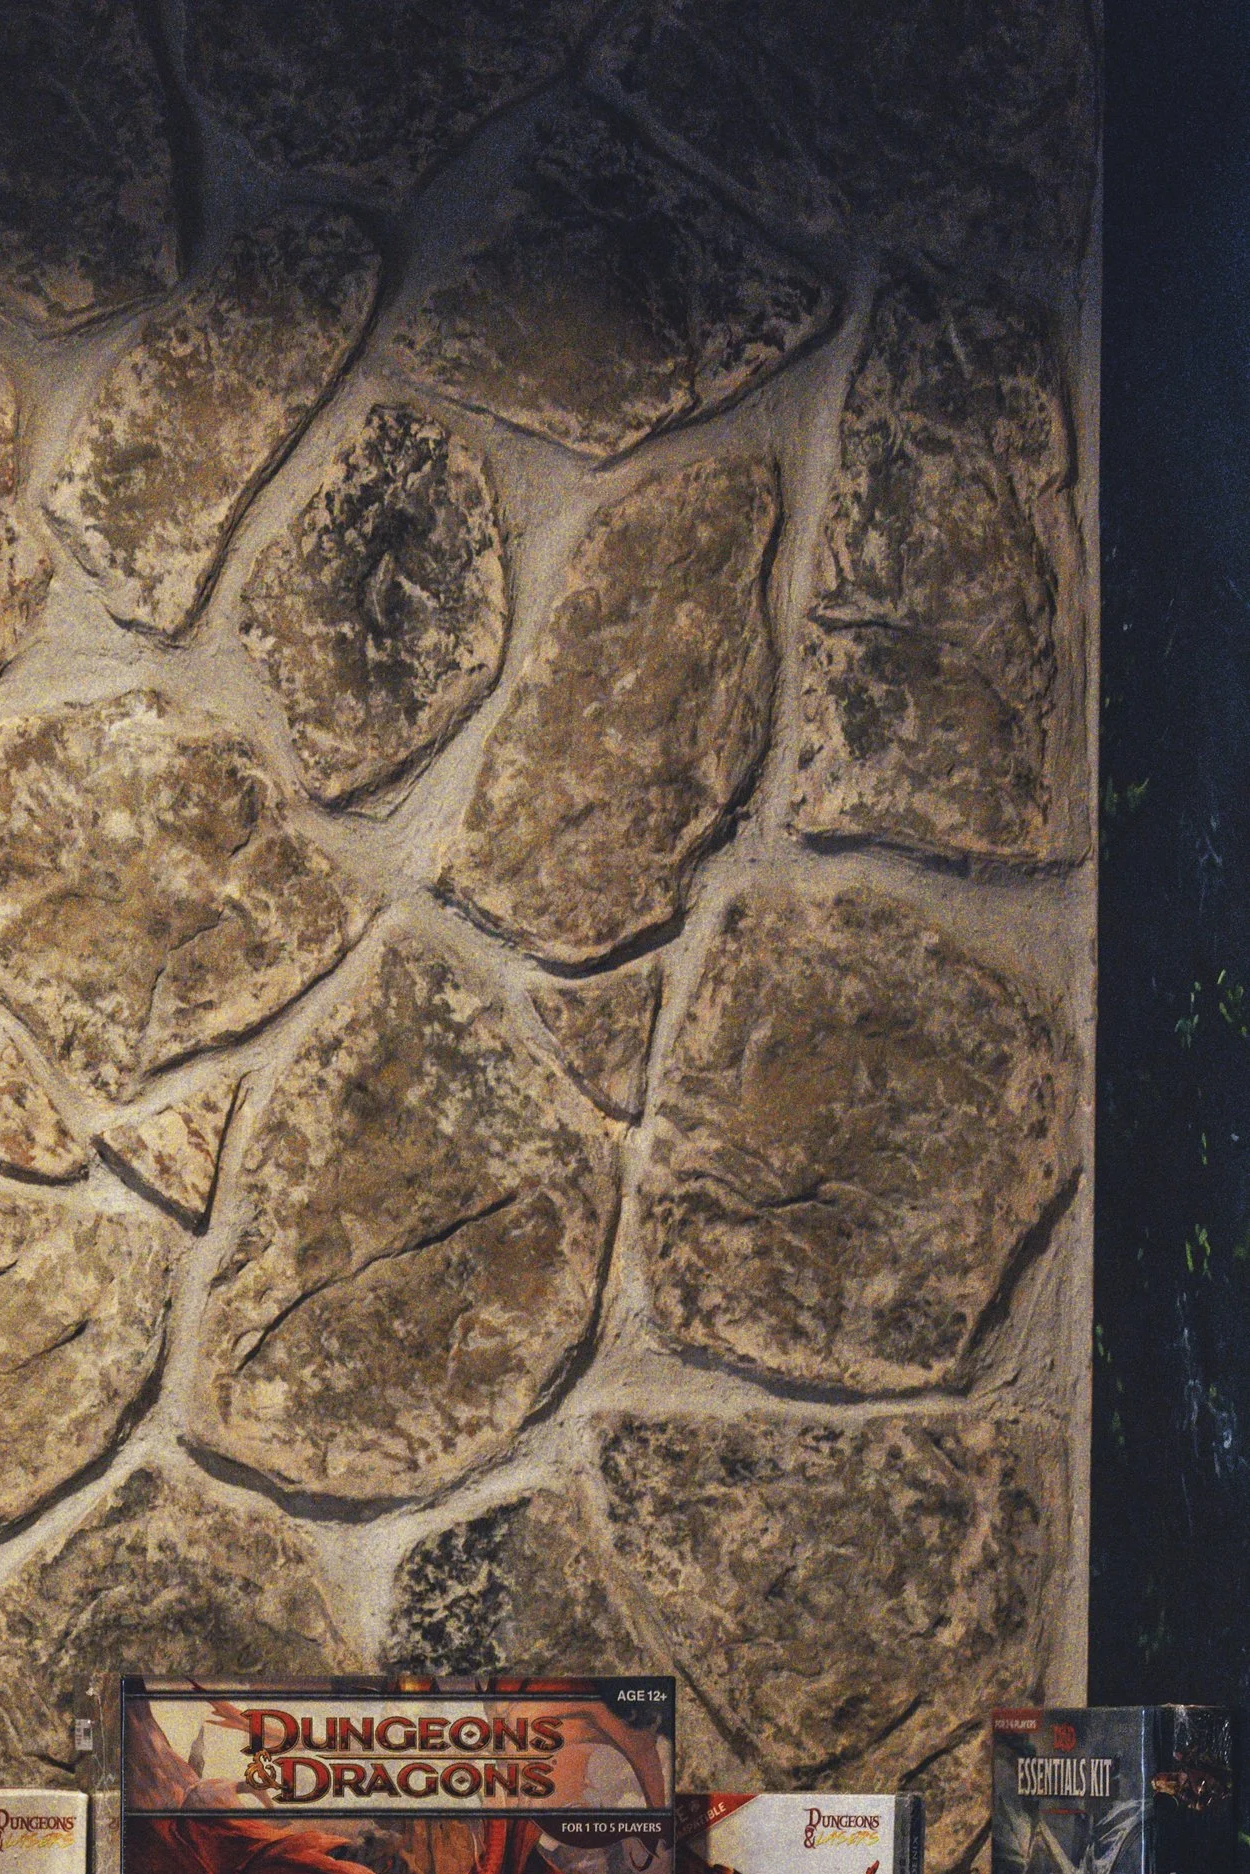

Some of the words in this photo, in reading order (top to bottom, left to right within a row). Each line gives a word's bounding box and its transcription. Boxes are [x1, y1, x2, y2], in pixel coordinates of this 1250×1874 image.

[617, 1690, 645, 1701] AGE
[648, 1690, 668, 1701] 12+
[240, 1708, 565, 1757] DUNGEONS
[271, 1756, 556, 1804] DRAGONS
[1017, 1757, 1087, 1797] ESSENTIALS
[1090, 1758, 1112, 1797] KIT
[562, 1822, 582, 1833] FOR
[585, 1822, 590, 1832] 1
[594, 1822, 607, 1832] TO
[610, 1822, 616, 1832] 5
[618, 1822, 662, 1832] PLAYERS
[803, 1808, 880, 1830] DUNGEONS
[803, 1826, 816, 1849] &
